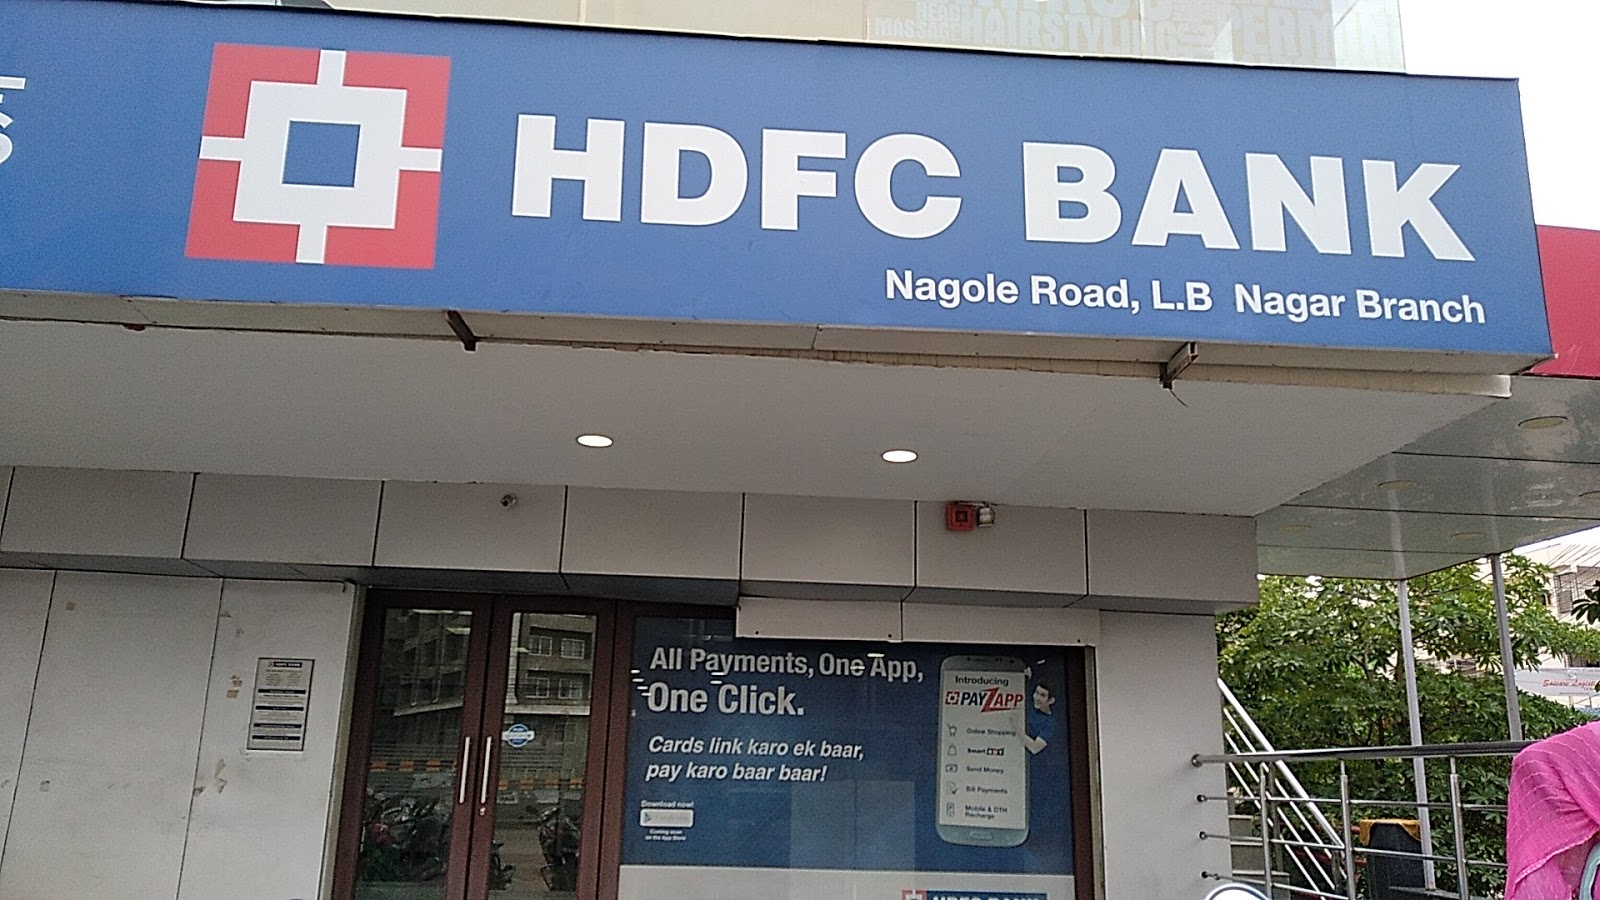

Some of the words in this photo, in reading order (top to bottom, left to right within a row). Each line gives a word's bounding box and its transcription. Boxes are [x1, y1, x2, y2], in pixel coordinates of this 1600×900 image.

[511, 113, 963, 240] HDFC
[1022, 141, 1476, 262] BANK
[885, 269, 1019, 309] Nagole
[1031, 275, 1140, 315] Road,
[1151, 280, 1213, 312] L.B
[1234, 283, 1346, 323] Nagar
[1356, 289, 1486, 324] Branch
[650, 647, 682, 670] All
[690, 648, 814, 679] Payments,
[819, 653, 865, 676] One
[870, 655, 924, 683] App,
[955, 675, 1009, 687] Introducing
[647, 682, 708, 713] One
[718, 683, 805, 716] Click.
[649, 735, 704, 754] Cards
[708, 737, 743, 755] link
[747, 738, 789, 756] karo
[793, 740, 815, 757] ek
[819, 741, 864, 761] baar,
[645, 762, 682, 782] pay
[685, 761, 728, 780] karo
[732, 763, 775, 781] baar
[778, 764, 828, 782] baar!
